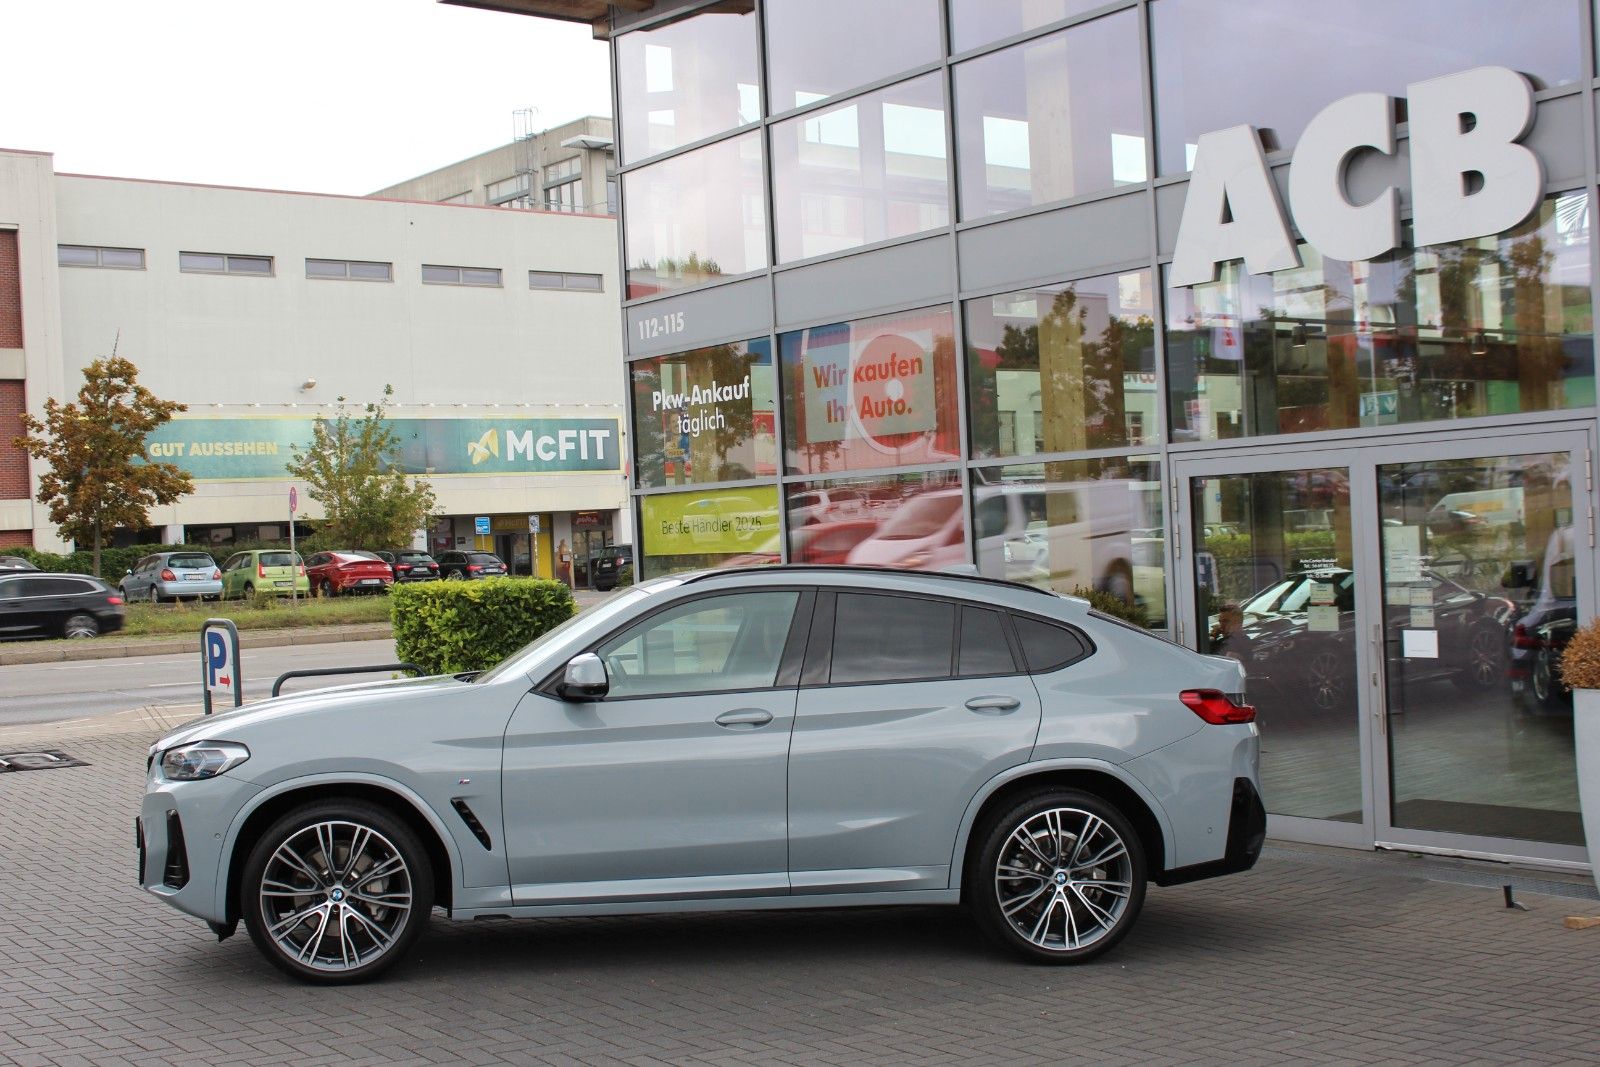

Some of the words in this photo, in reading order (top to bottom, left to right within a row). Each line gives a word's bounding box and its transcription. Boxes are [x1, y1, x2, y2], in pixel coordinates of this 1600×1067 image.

[1168, 66, 1545, 288] ACB
[638, 312, 685, 340] 112-115
[812, 363, 848, 389] Wir
[853, 352, 923, 384] kaufen
[652, 375, 750, 411] Pkw-Ankauf
[859, 395, 912, 420] Auto.
[677, 407, 725, 437] täglich
[150, 443, 185, 457] GUT
[189, 441, 278, 457] AUSSEHEN
[506, 429, 610, 461] McFIT
[661, 519, 690, 535] Beste
[692, 517, 732, 534] Händler
[735, 515, 762, 532] 2025
[207, 631, 227, 687] P
